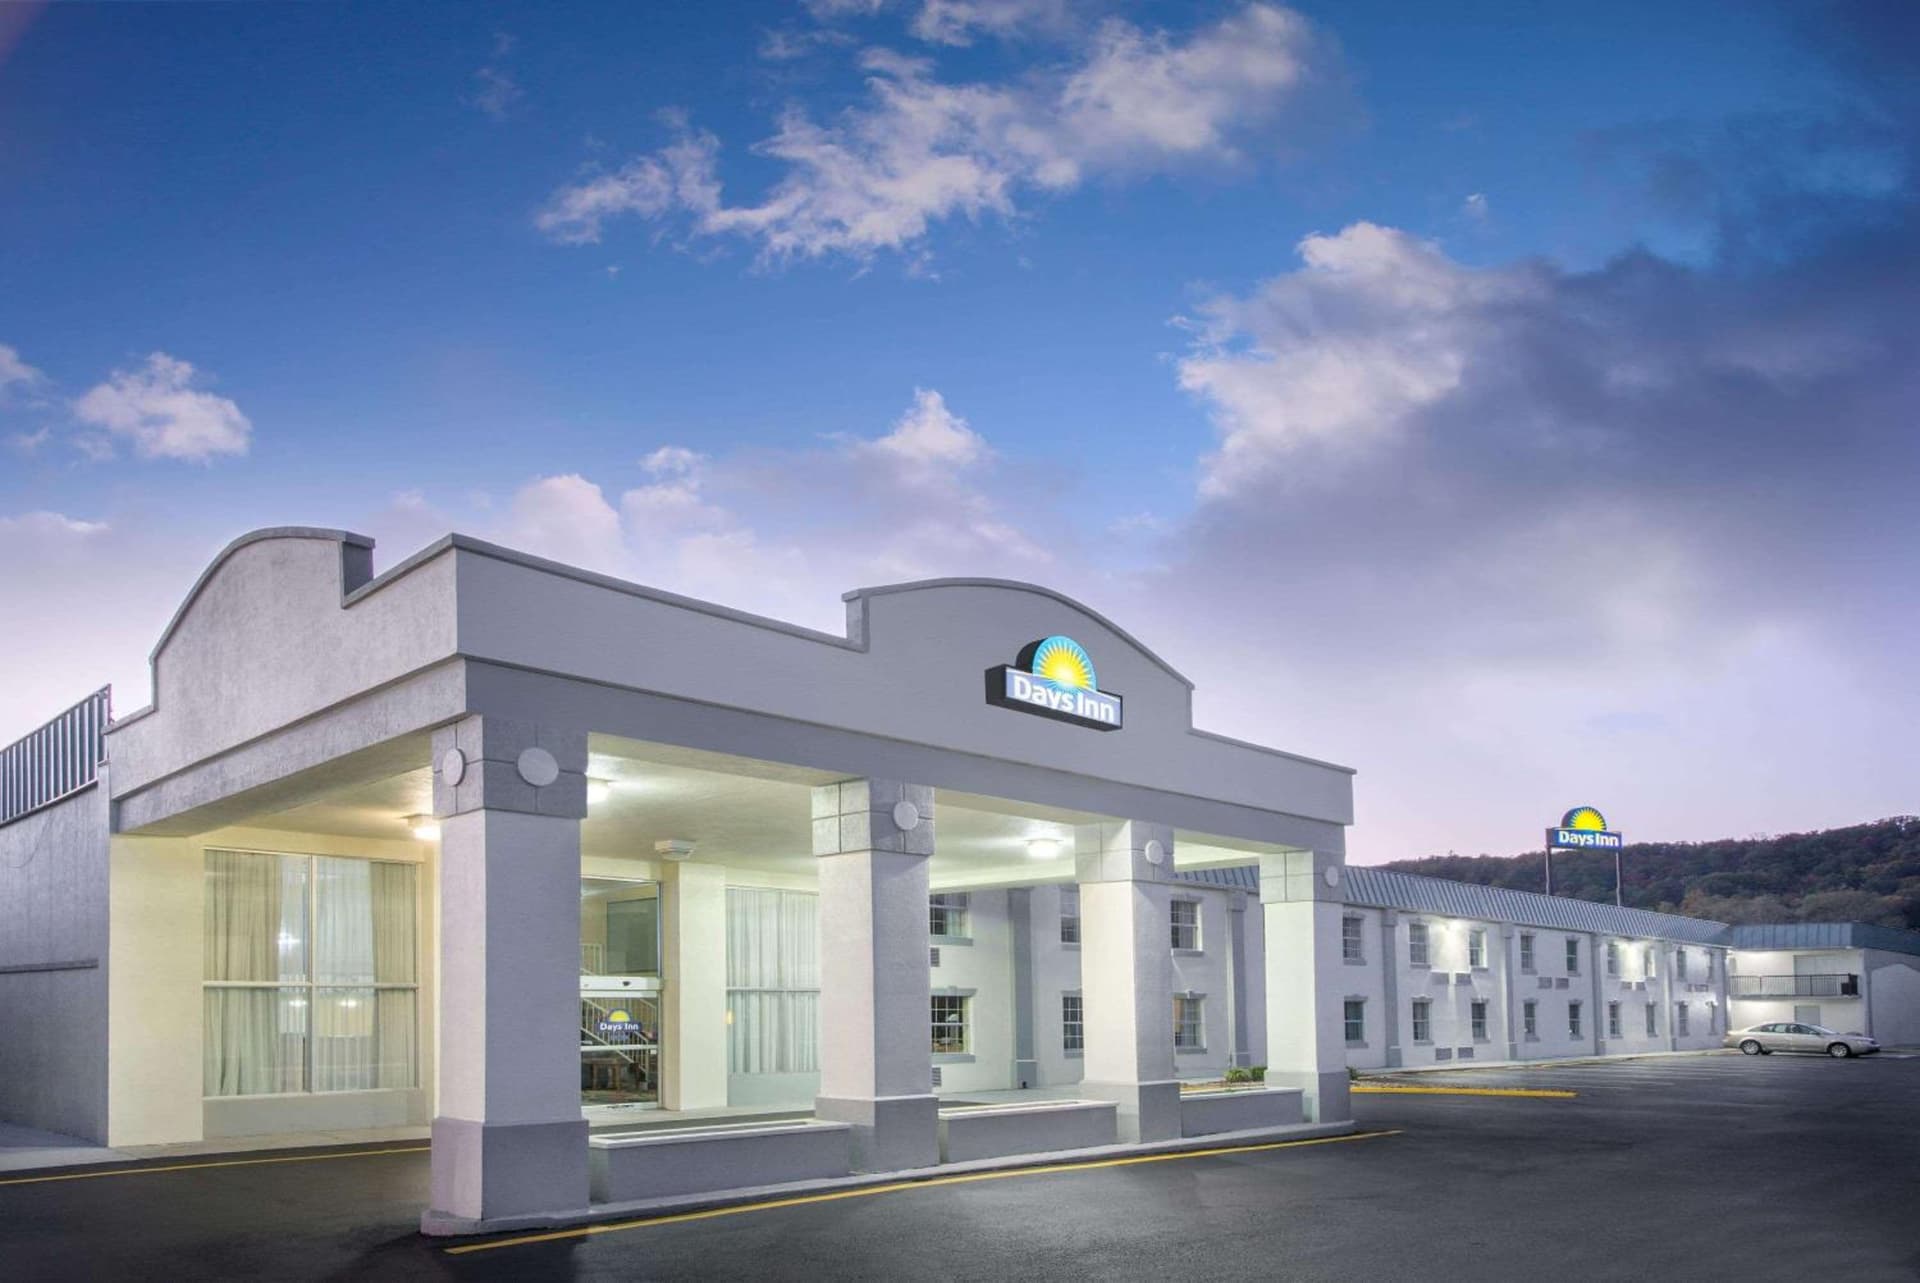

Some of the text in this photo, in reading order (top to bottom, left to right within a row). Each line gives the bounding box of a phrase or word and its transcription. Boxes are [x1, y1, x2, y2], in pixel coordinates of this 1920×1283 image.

[1013, 675, 1114, 722] Days Inn
[1559, 831, 1618, 846] Days Inn
[600, 1023, 622, 1031] Days
